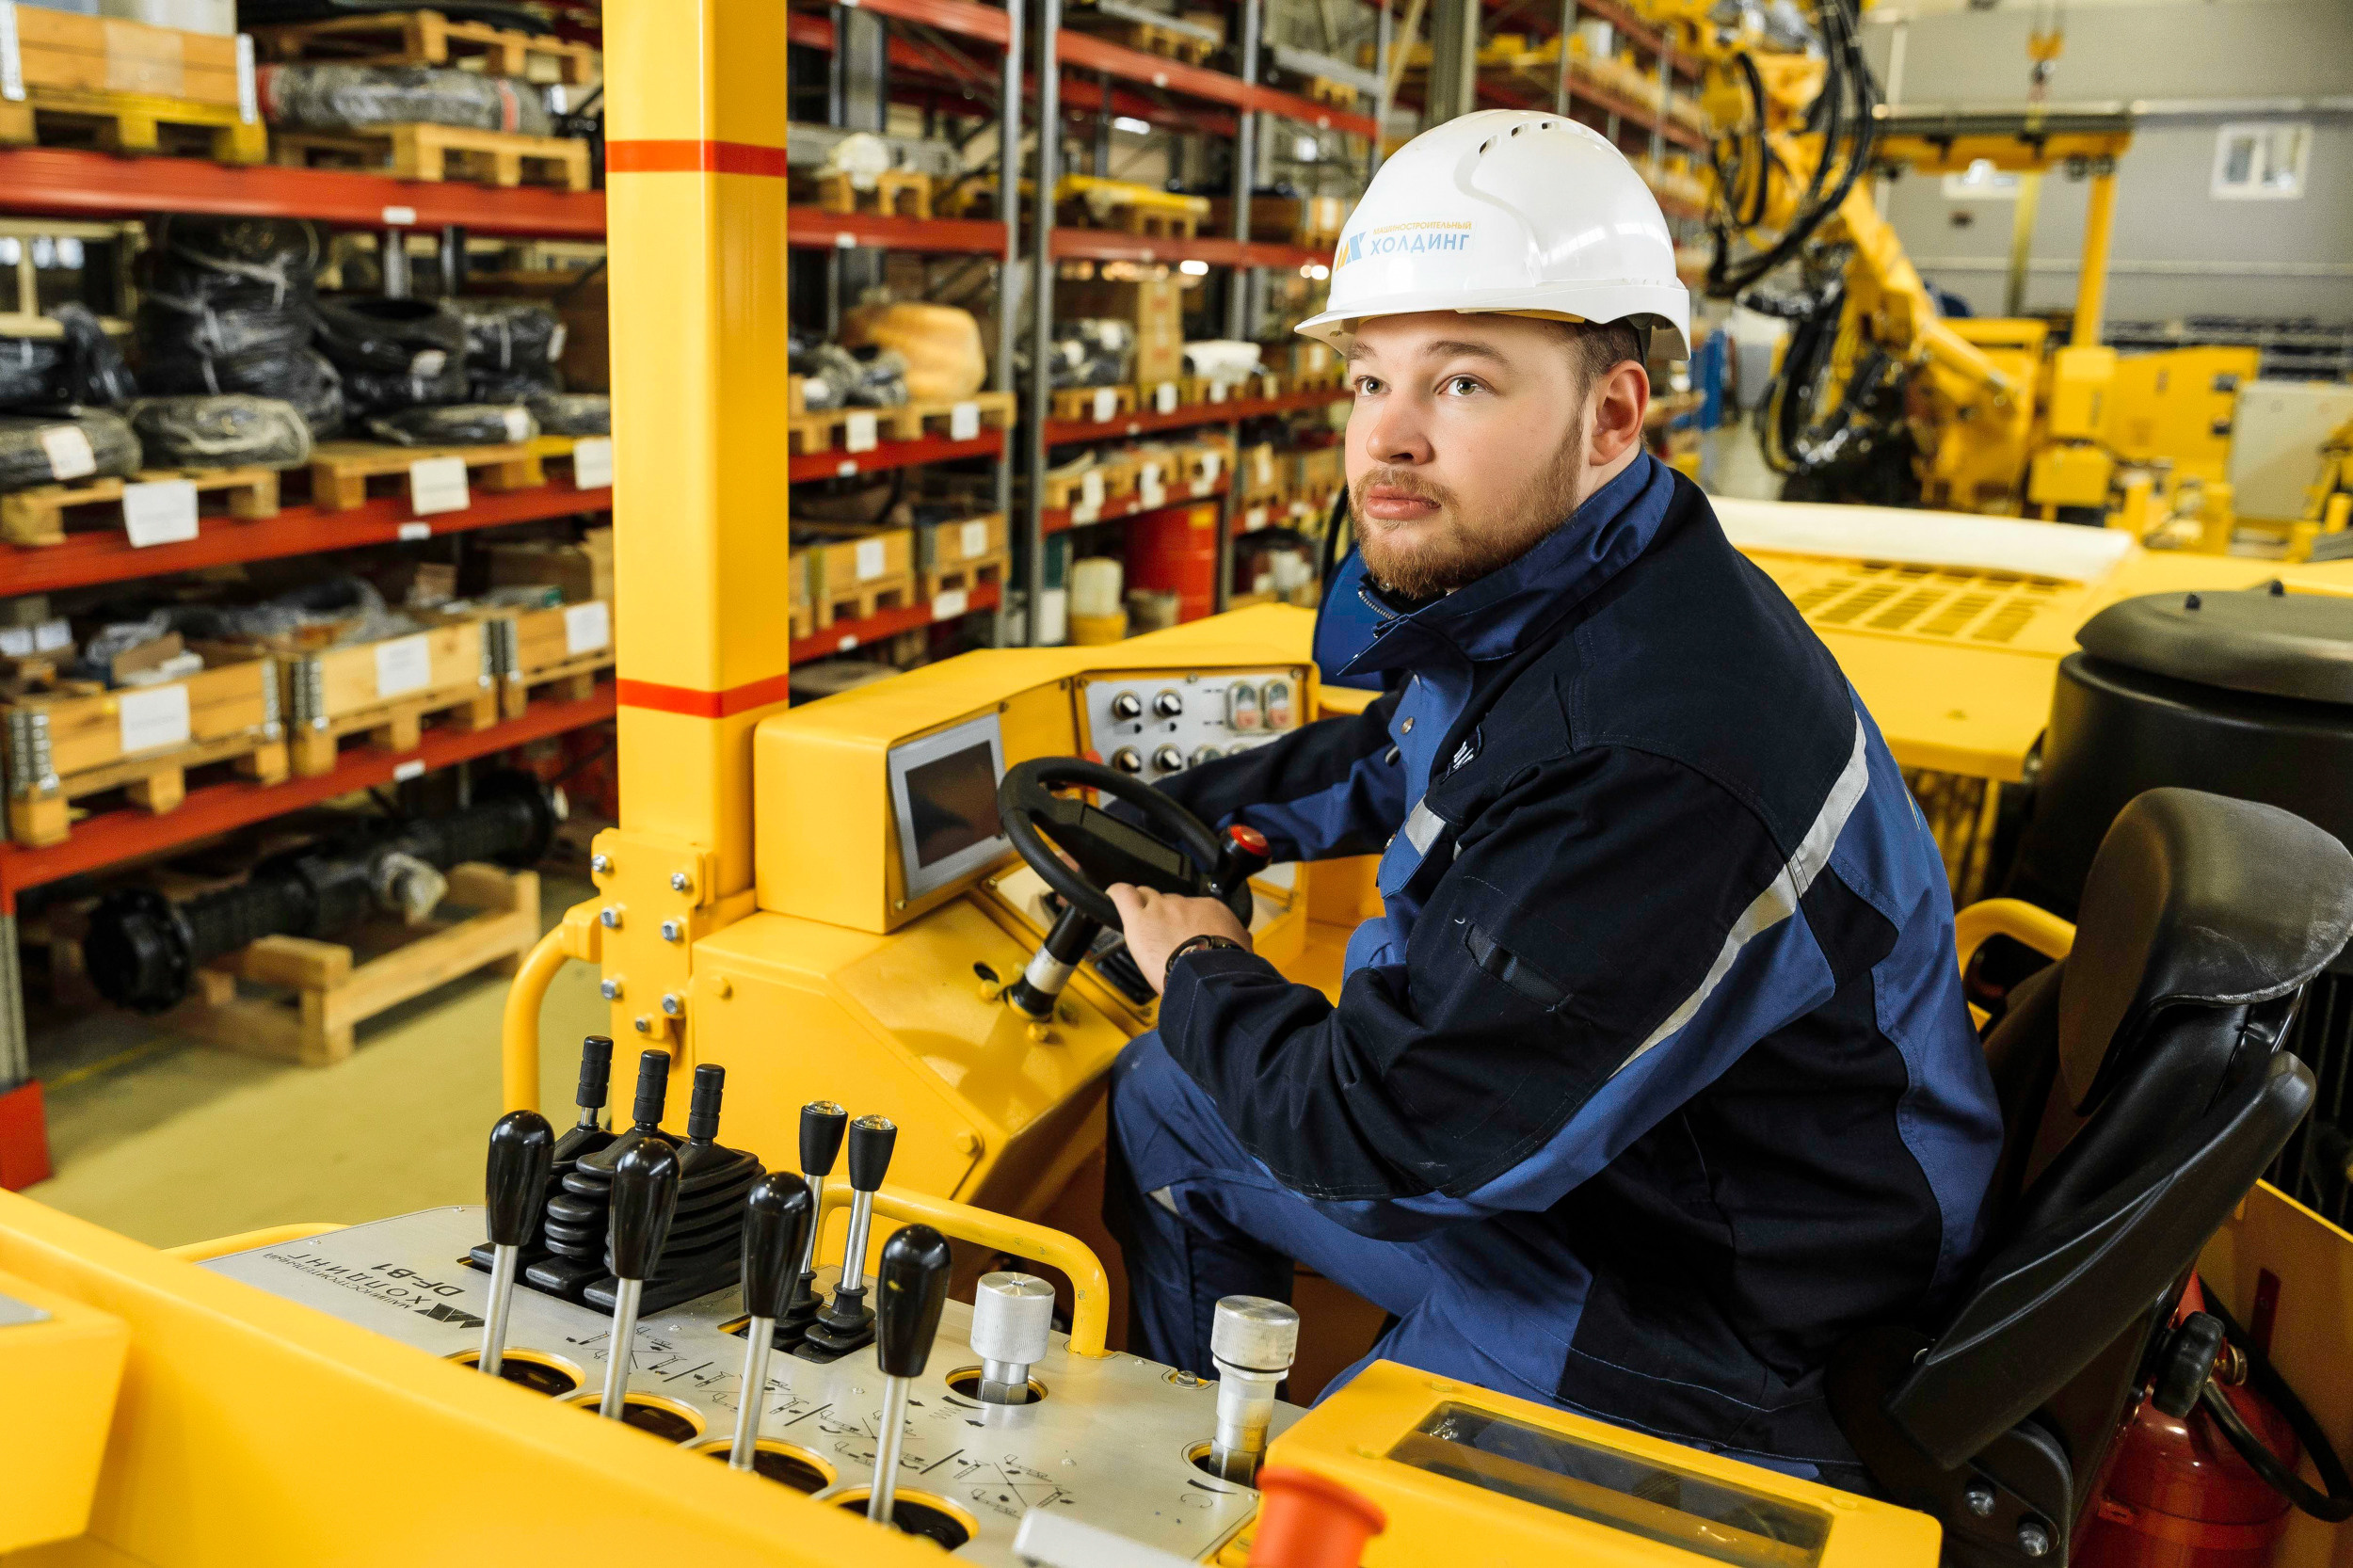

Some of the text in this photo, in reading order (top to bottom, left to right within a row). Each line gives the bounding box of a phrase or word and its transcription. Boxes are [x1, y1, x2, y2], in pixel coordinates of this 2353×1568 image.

[1370, 233, 1470, 255] ХОЛДИНГ
[1373, 221, 1472, 234] МАШИНОСТРОИТЕЛЬНЫЙ
[263, 1252, 413, 1309] МАШИНОСТРОИТЕЛЬНЫЙ
[287, 1254, 432, 1304] ХОЛДИНГ
[371, 1263, 466, 1297] DF-B1
